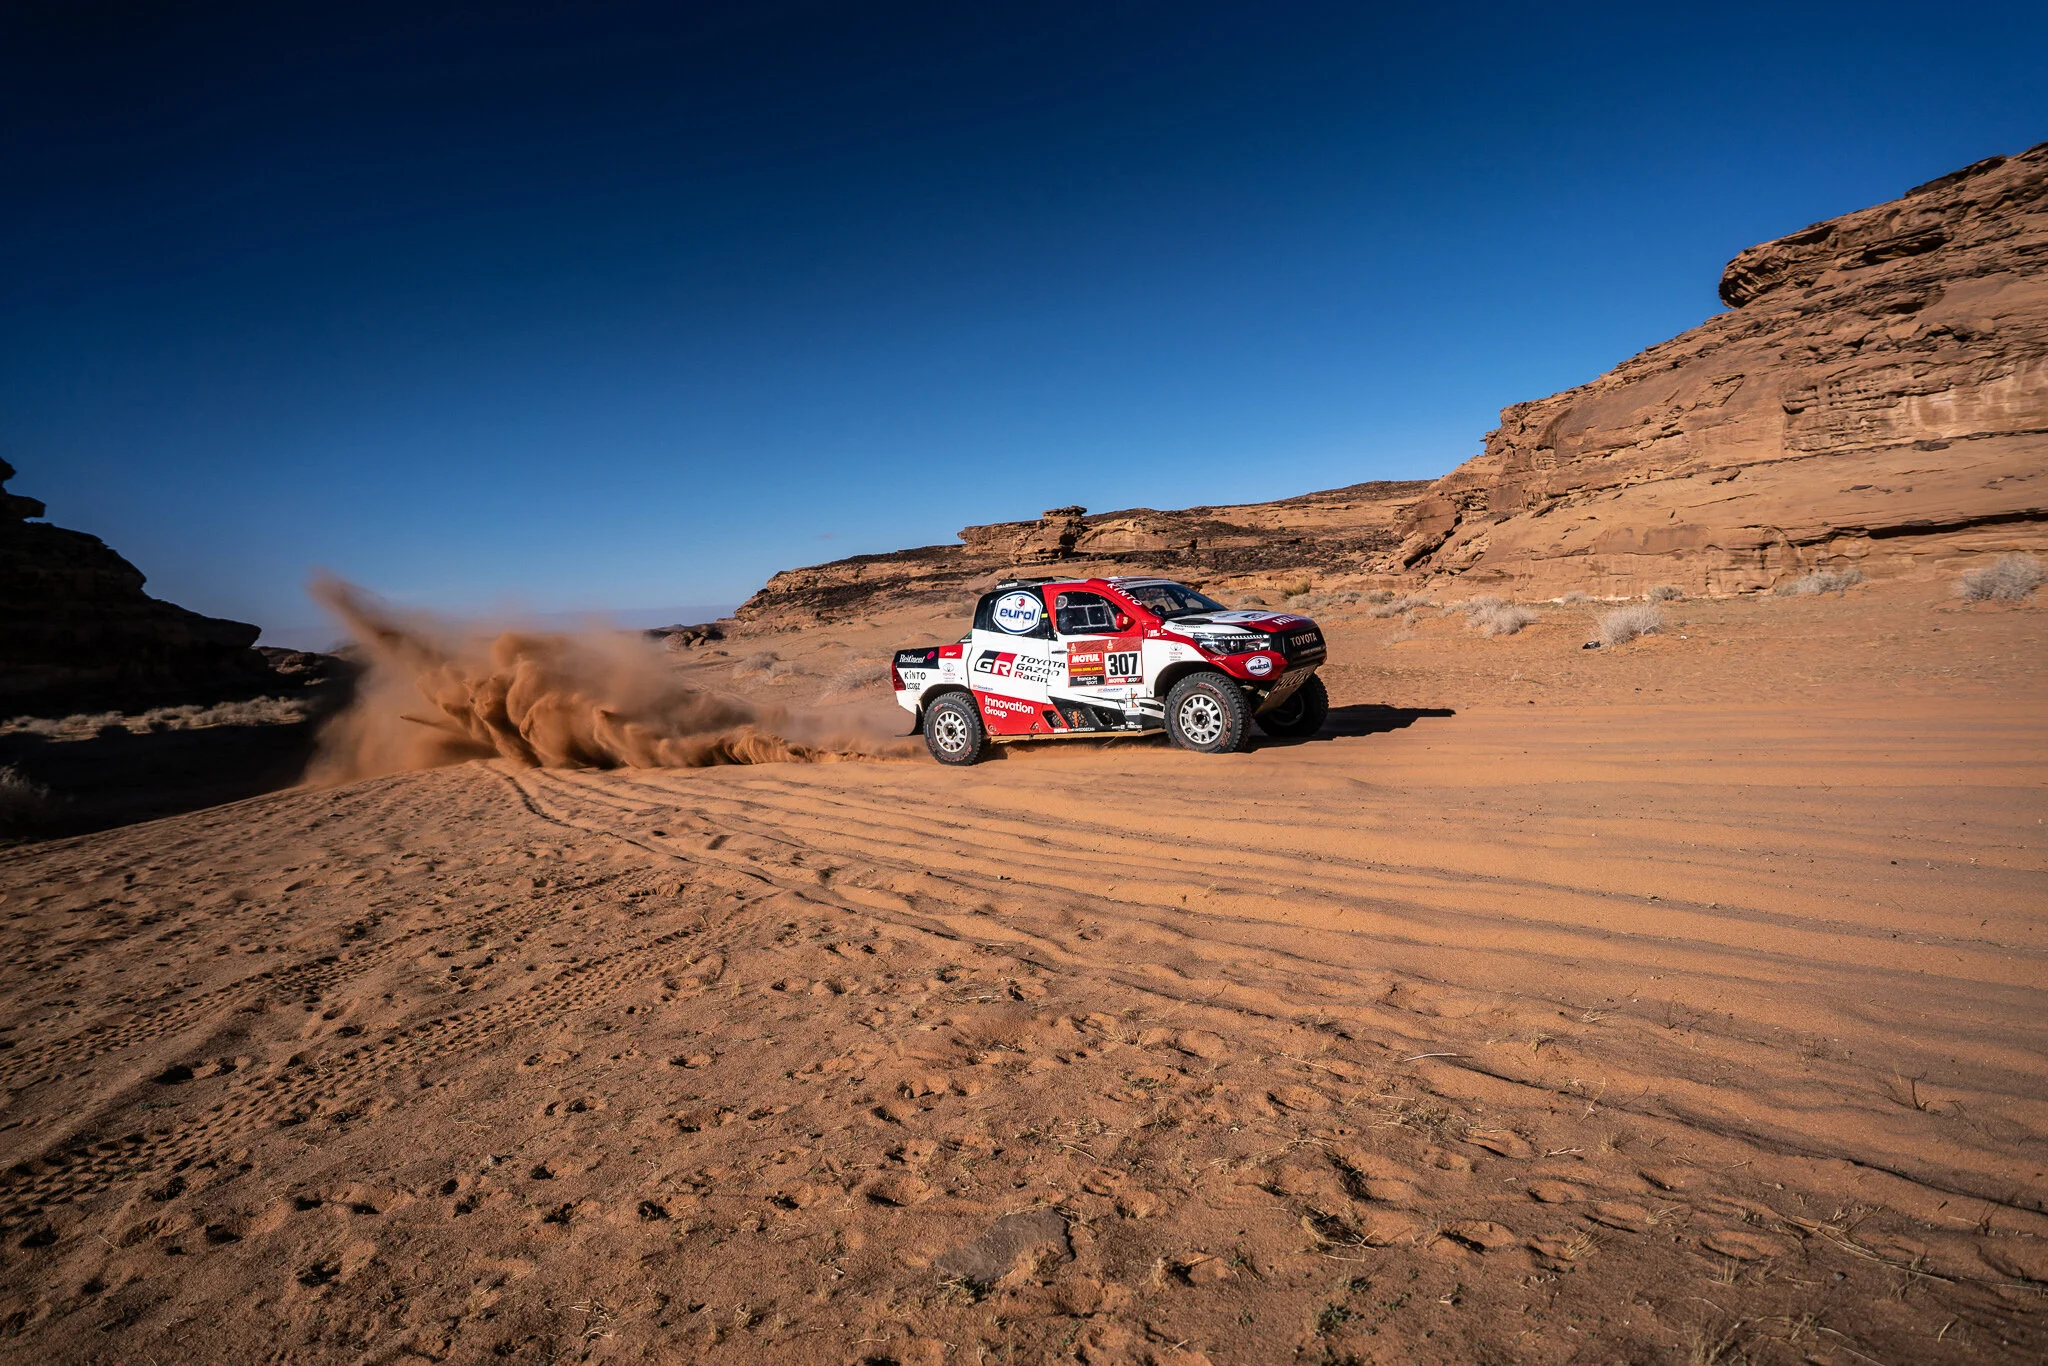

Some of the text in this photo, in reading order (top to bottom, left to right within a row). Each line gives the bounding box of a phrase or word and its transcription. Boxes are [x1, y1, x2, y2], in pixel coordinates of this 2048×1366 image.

[1107, 583, 1143, 606] KINTO
[999, 608, 1036, 621] eurol
[1290, 632, 1318, 647] TOYOTA
[1020, 655, 1066, 669] TOYOTA
[1072, 654, 1100, 663] MOTUL
[1108, 653, 1138, 676] 307
[974, 658, 1011, 677] GR
[1250, 662, 1270, 671] eurol
[984, 695, 1035, 714] Innovation
[984, 706, 1008, 719] Group
